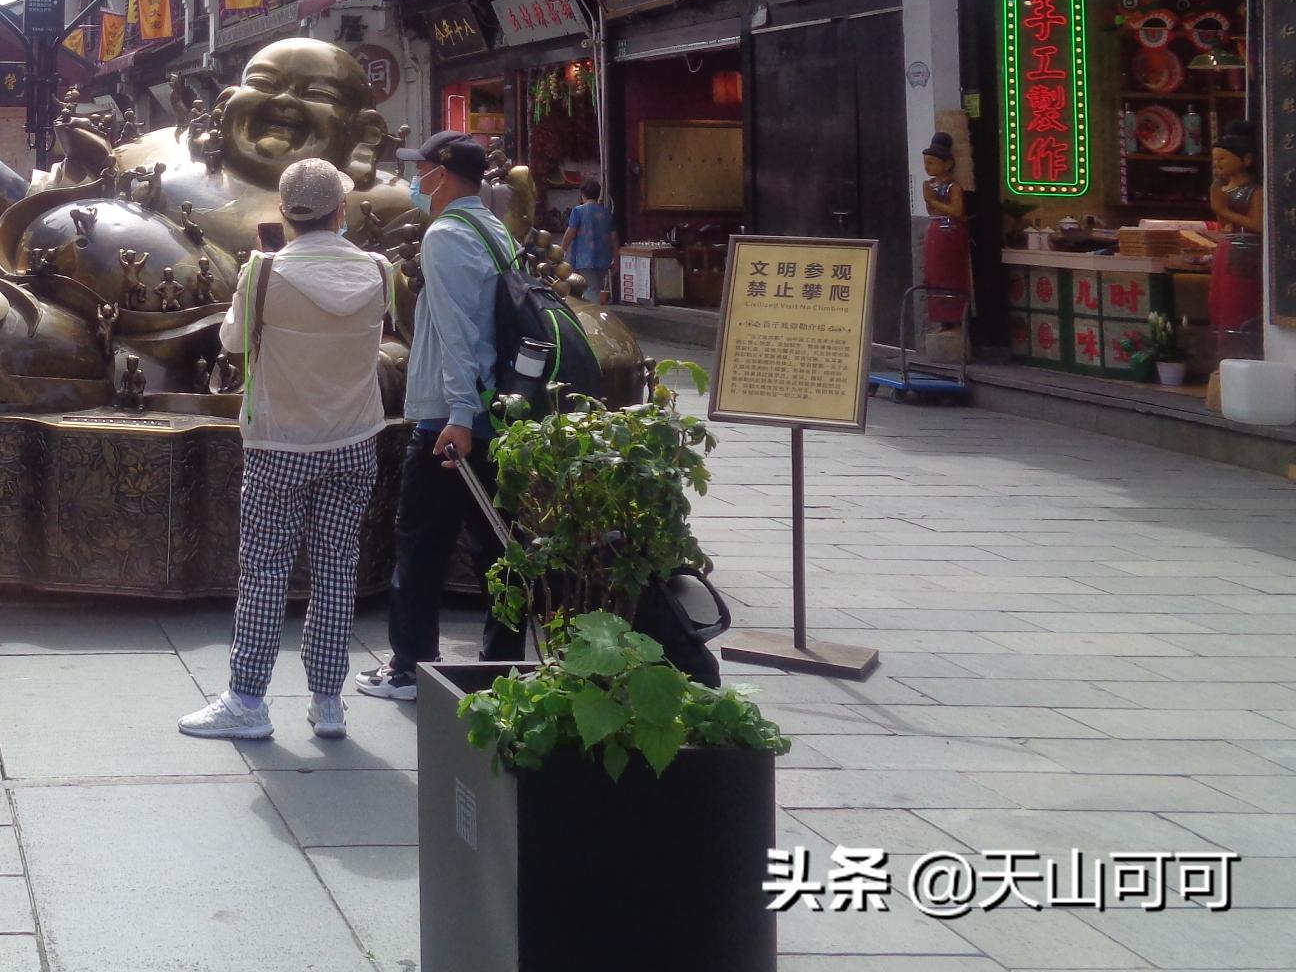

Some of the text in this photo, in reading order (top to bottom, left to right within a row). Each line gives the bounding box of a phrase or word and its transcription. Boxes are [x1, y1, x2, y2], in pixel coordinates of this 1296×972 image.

[749, 260, 853, 281] 文明参观
[746, 280, 851, 302] 禁止攀爬
[745, 300, 779, 309] Civilized
[780, 301, 798, 310] Visit
[812, 303, 850, 314] Climbing
